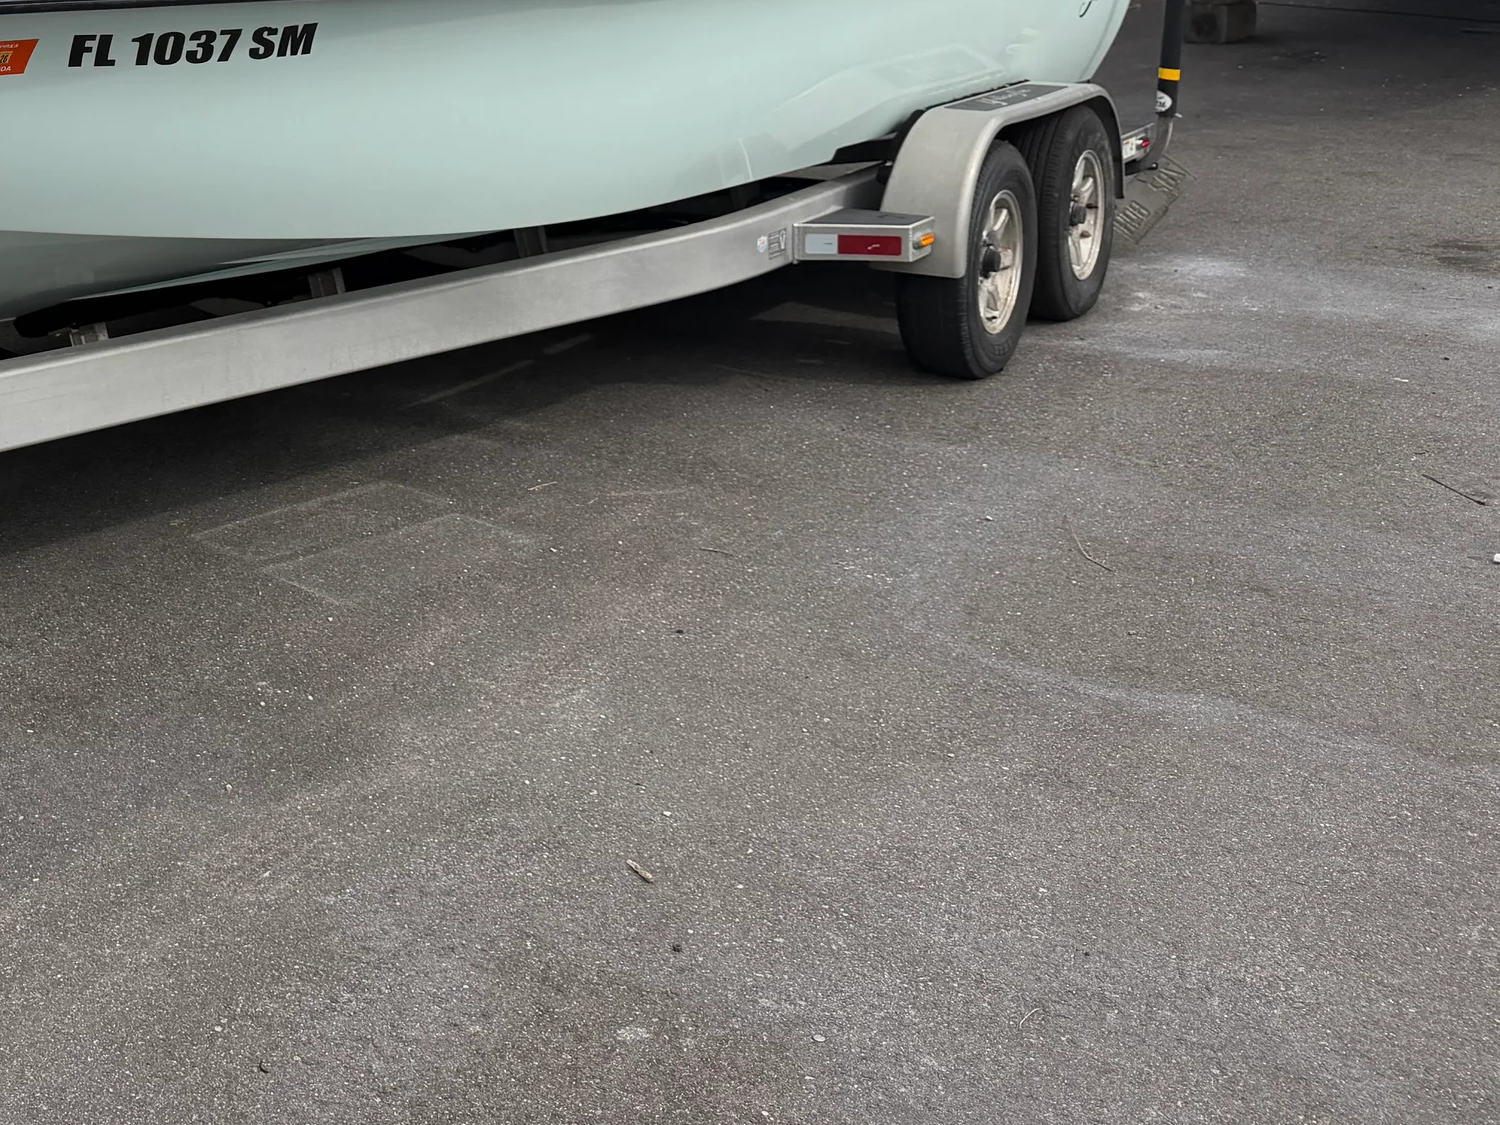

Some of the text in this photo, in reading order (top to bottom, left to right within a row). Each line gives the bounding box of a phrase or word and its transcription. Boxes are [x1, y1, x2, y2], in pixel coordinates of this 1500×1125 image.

[68, 22, 319, 67] FL 1037 SM
